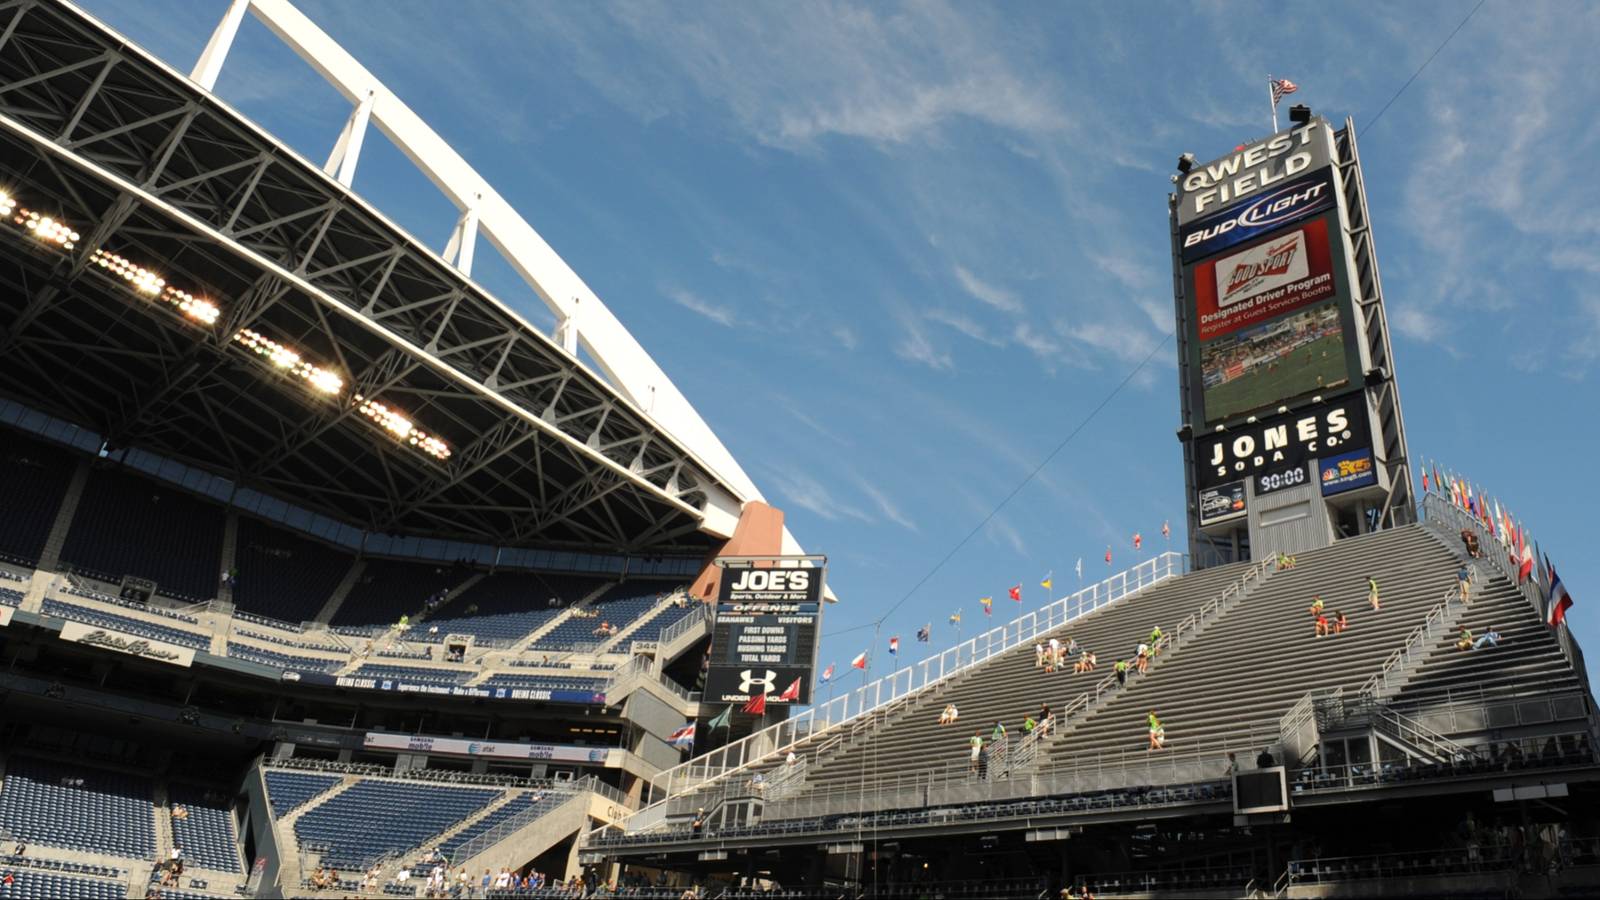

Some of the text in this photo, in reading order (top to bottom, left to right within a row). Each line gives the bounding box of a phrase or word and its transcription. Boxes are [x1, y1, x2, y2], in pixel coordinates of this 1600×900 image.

[1183, 122, 1317, 192] QWEST
[1195, 151, 1312, 213] FIELD
[1184, 219, 1236, 247] BUD
[1250, 182, 1328, 222] LIGHT
[1200, 299, 1254, 324] Designated
[1255, 289, 1285, 305] Driver
[1286, 272, 1331, 295] Program
[1201, 318, 1235, 334] Register
[1243, 305, 1267, 319] Guest
[1268, 297, 1300, 311] Services
[1301, 285, 1332, 299] Booths
[1211, 408, 1348, 466] JONES
[1217, 451, 1284, 477] SODA
[1260, 467, 1305, 491] 90:00
[731, 570, 809, 591] JOE'S
[732, 604, 801, 612] OFFENSE
[717, 616, 813, 624] SEAHAWKS VISITORS
[743, 626, 785, 634] FIRST DOWNS
[738, 635, 787, 644] PASSING YARDS
[737, 644, 787, 653] RUSHING YARDS
[741, 654, 781, 662] TOTAL YARDS
[354, 679, 376, 688] CLASSIC
[530, 689, 551, 700] CLASSIC
[721, 694, 750, 702] UNDER
